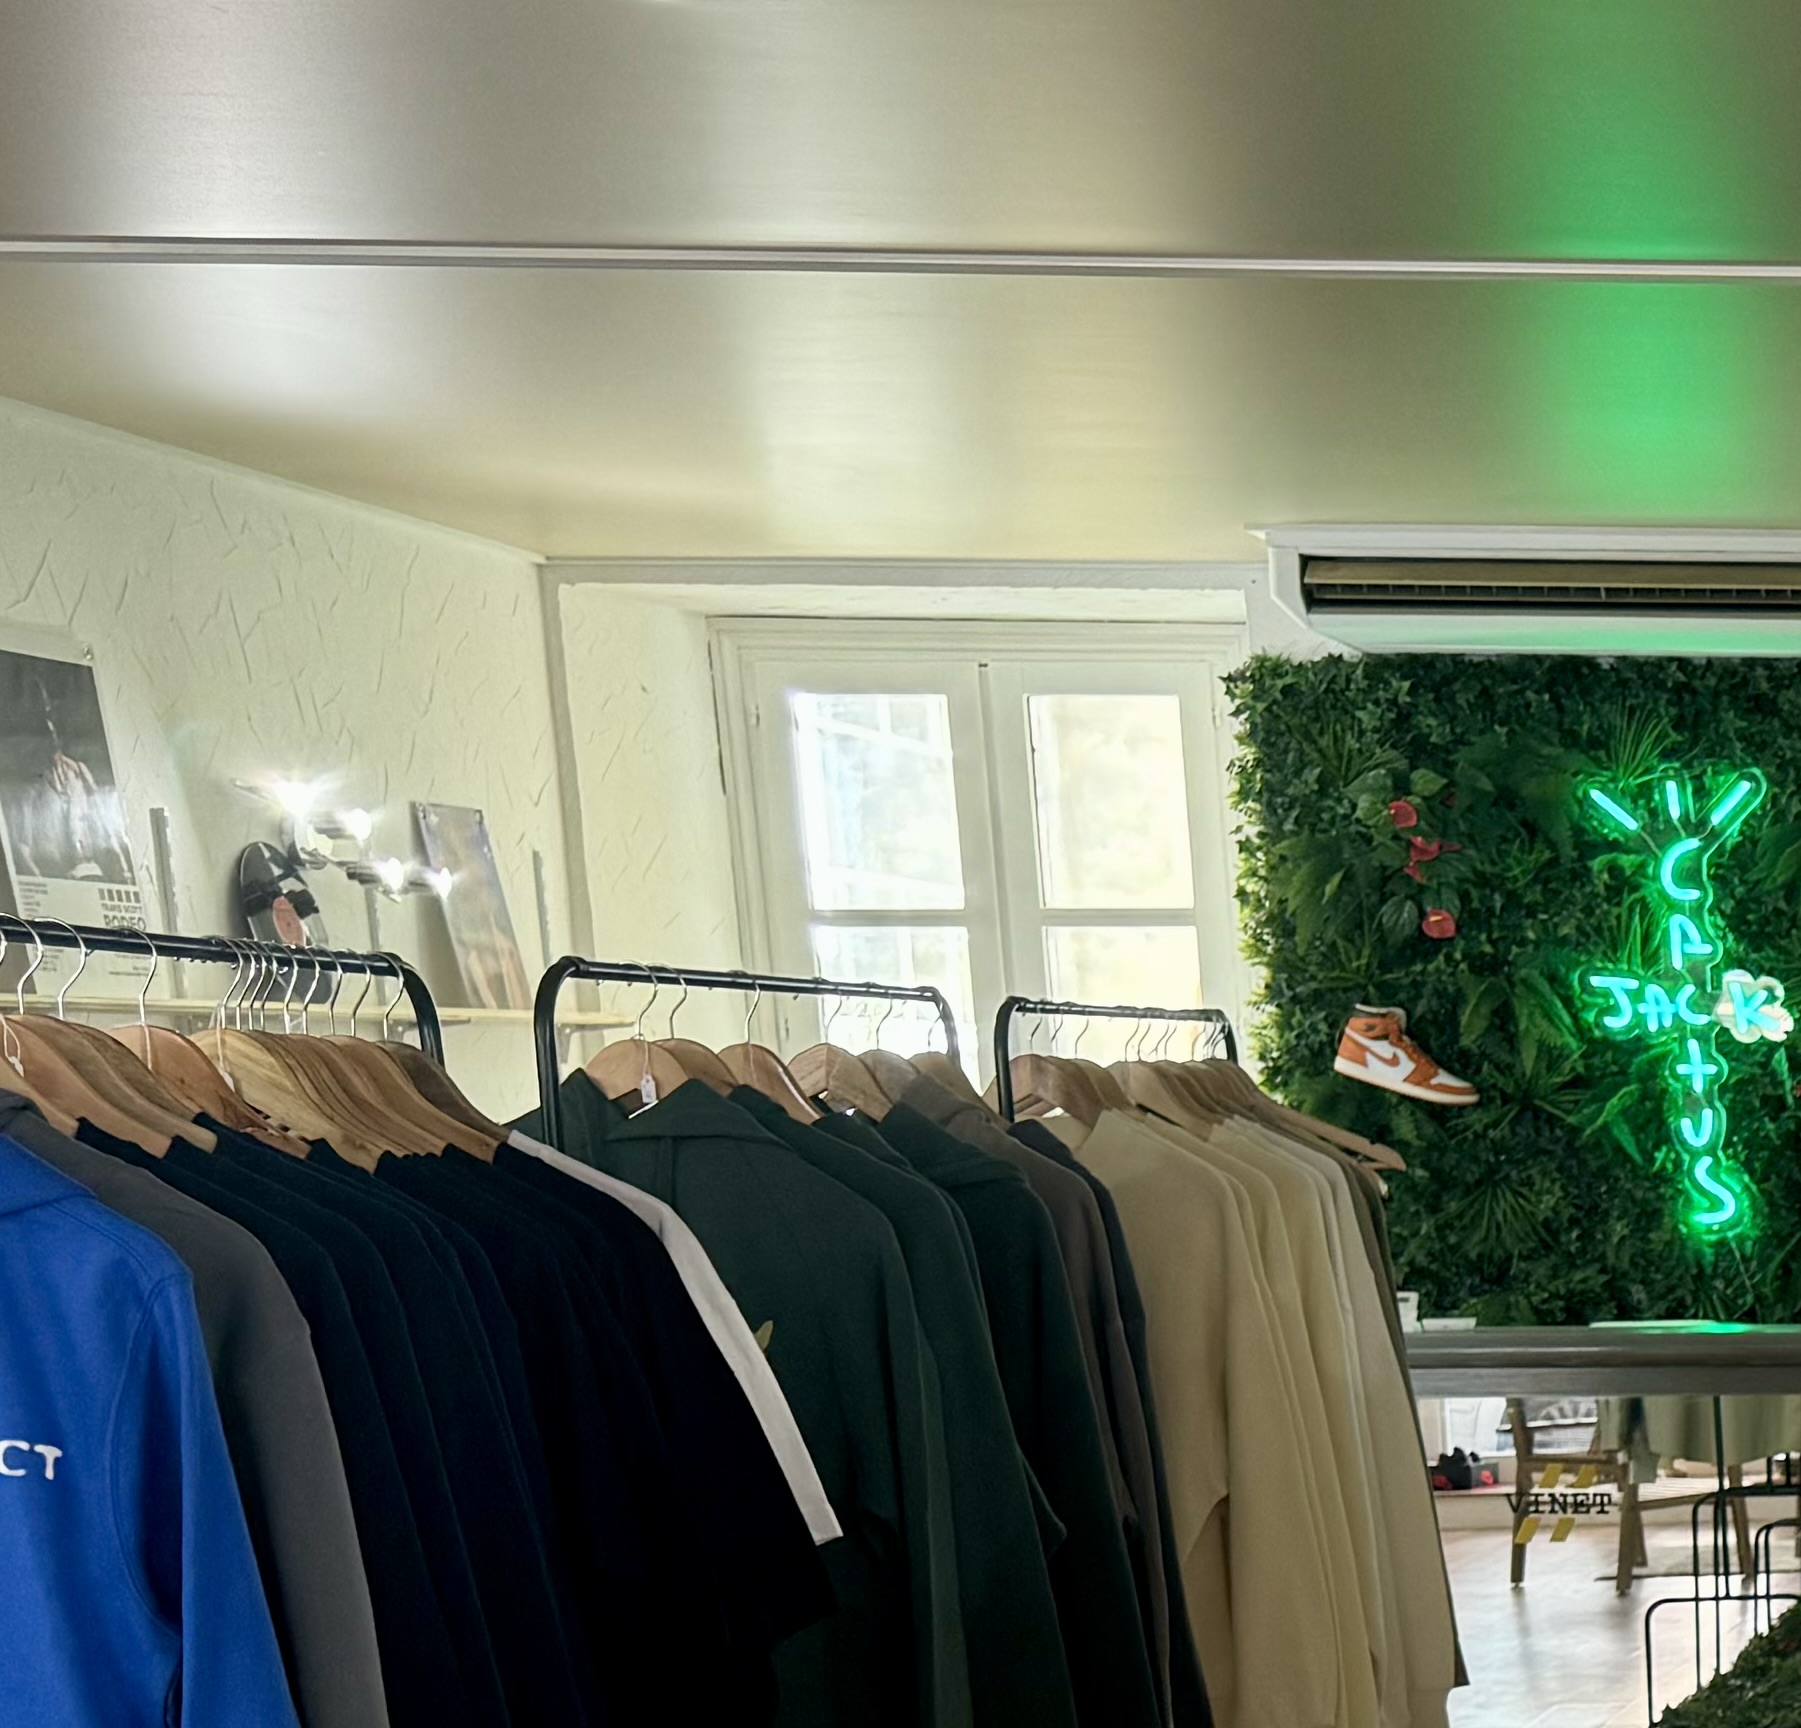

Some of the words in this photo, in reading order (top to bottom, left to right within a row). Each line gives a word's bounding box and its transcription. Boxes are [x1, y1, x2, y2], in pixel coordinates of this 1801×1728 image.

[1590, 975, 1790, 1037] JACK
[0, 1440, 63, 1480] CT
[1505, 1493, 1611, 1514] VINET
